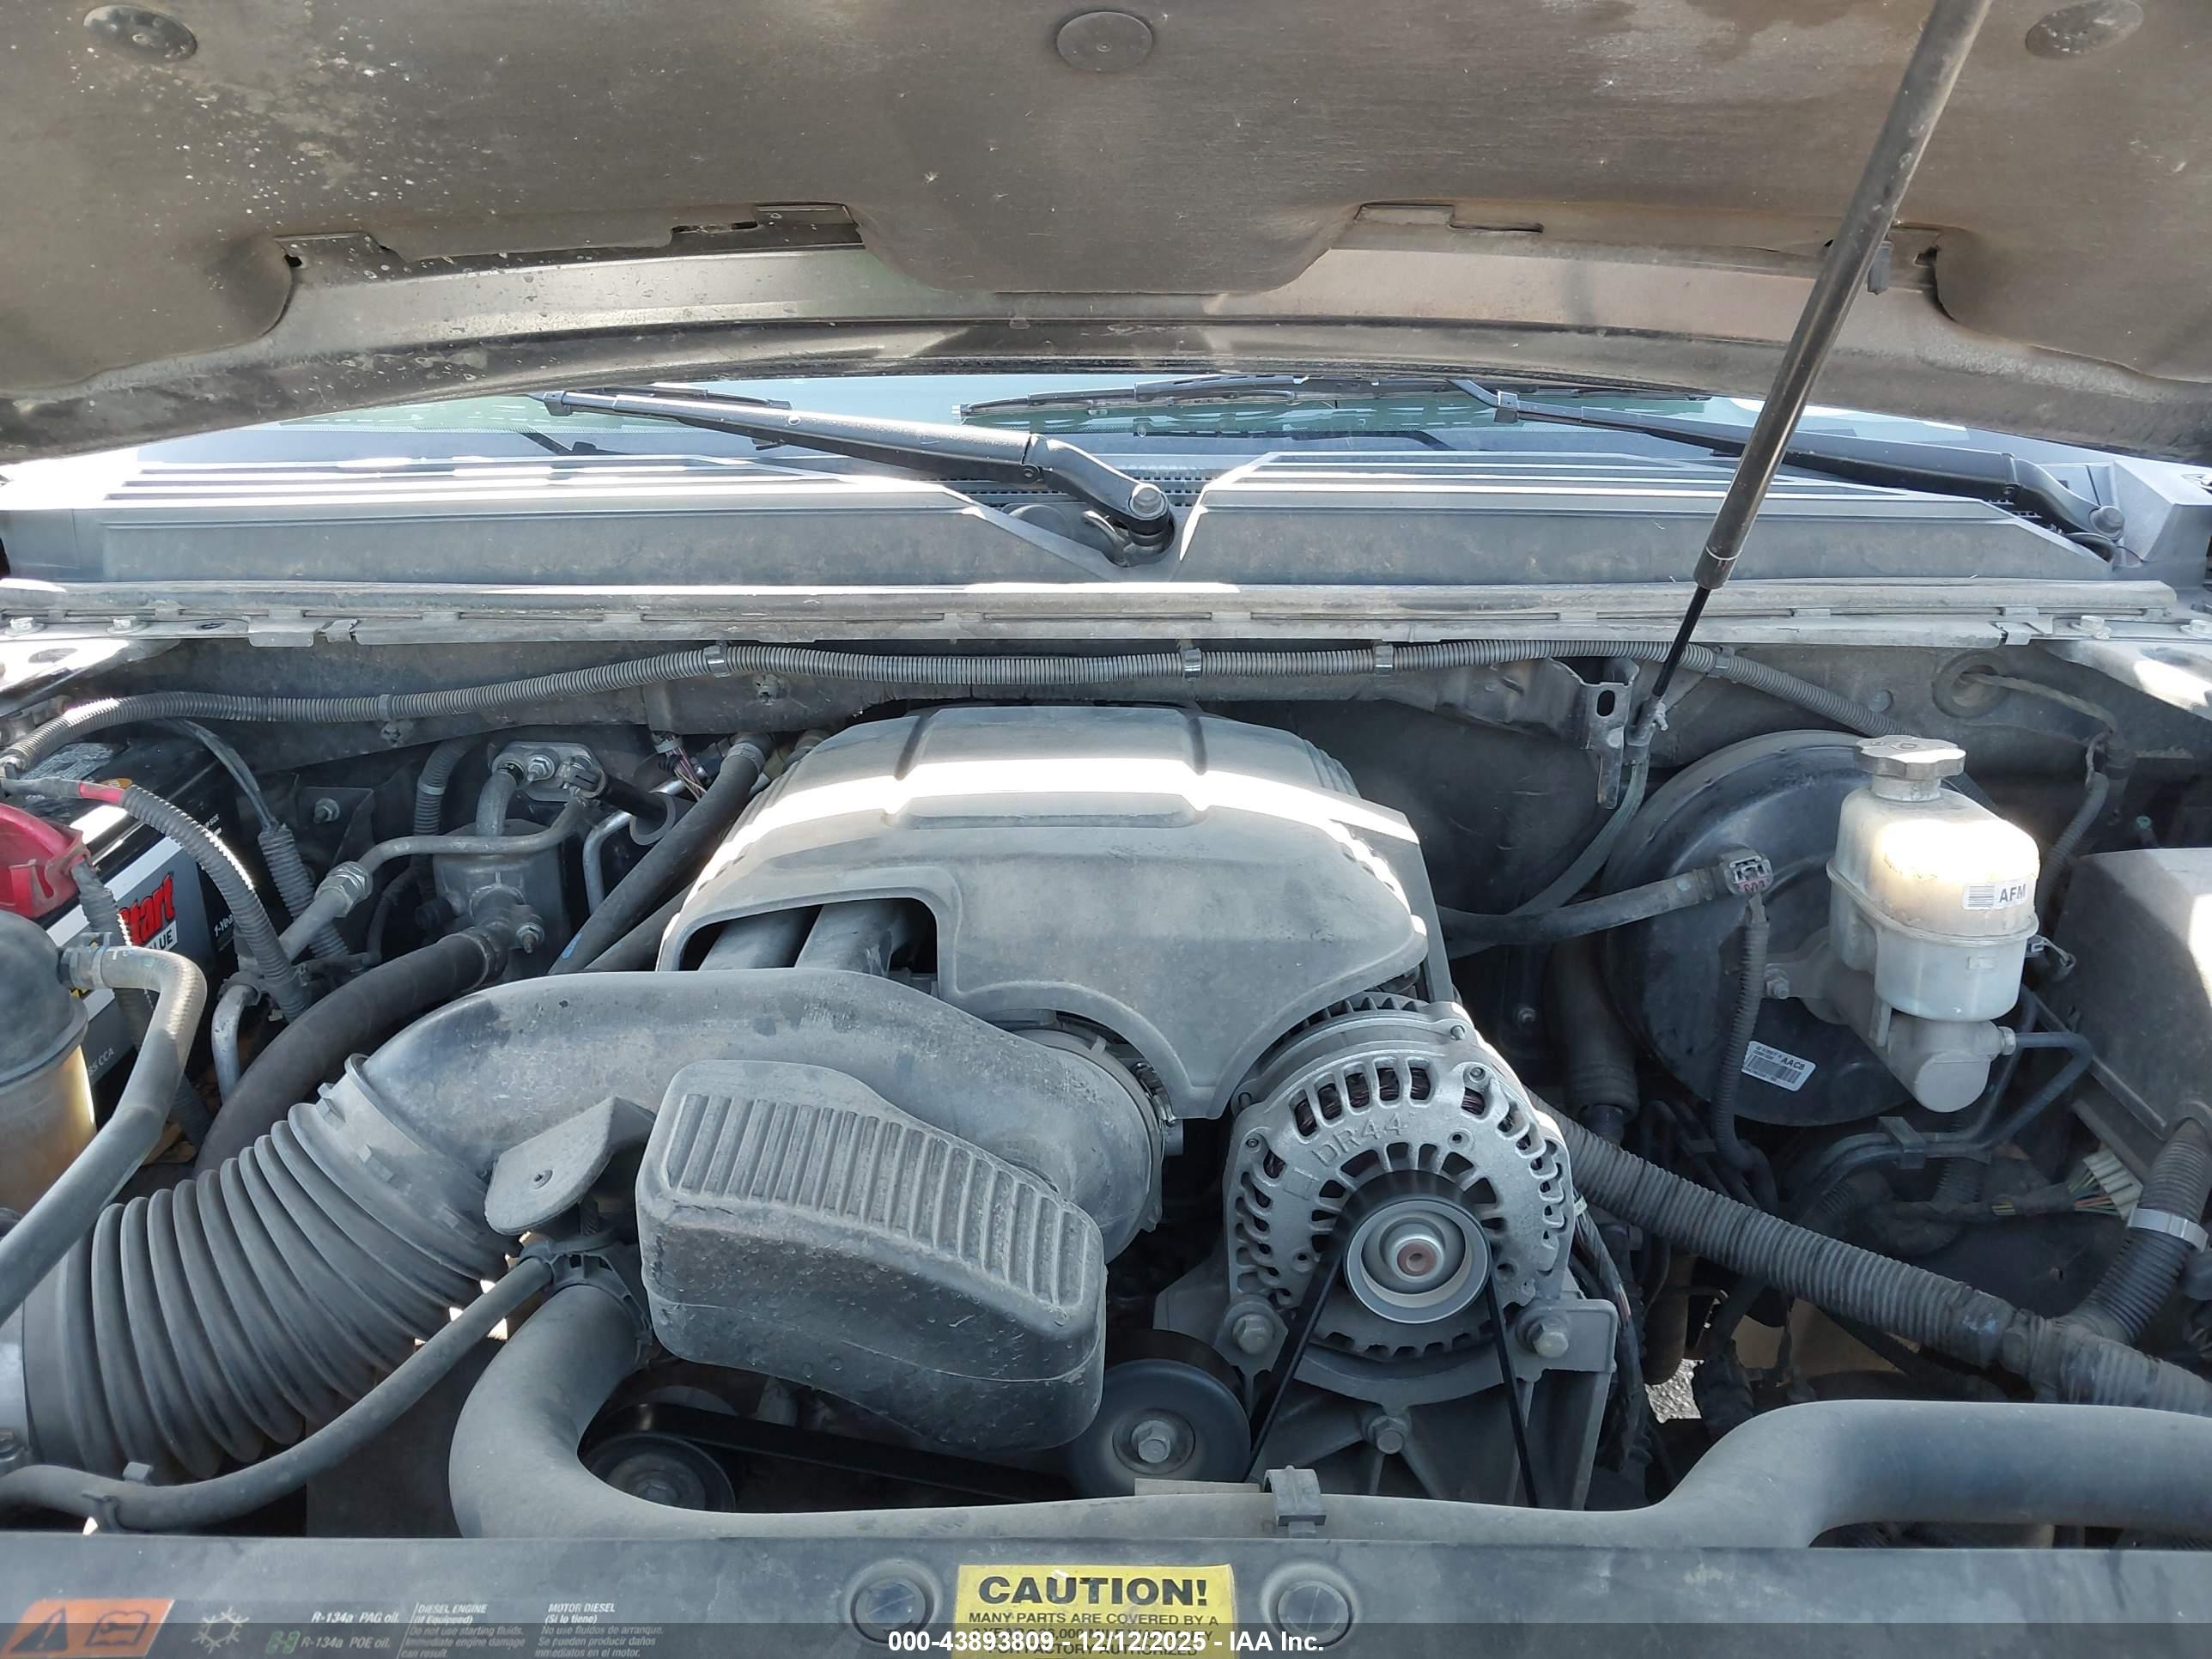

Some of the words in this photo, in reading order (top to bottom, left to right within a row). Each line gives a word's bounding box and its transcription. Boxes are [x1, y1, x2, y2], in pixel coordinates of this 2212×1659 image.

[1998, 883, 2027, 903] AFM
[149, 929, 173, 950] LUE
[98, 1047, 115, 1066] CCA
[978, 1575, 1206, 1606] CAUTION!
[418, 1604, 449, 1613] DIESEL
[453, 1604, 488, 1614] ENGINE
[549, 1603, 581, 1613] MOTOR
[584, 1603, 615, 1613] DIESEL
[311, 1611, 354, 1623] R-134a
[359, 1612, 382, 1623] PAG
[969, 1613, 1012, 1623] MANY
[1017, 1613, 1065, 1623] PARTS
[1071, 1613, 1101, 1624] ARE
[1105, 1613, 1178, 1626] COVERED
[1183, 1615, 1203, 1626] BY
[1208, 1616, 1218, 1626] A
[607, 1626, 618, 1634] de
[301, 1636, 344, 1648] R-134a
[349, 1636, 374, 1649] POE
[455, 1638, 487, 1649] engine
[489, 1638, 526, 1650] damage
[587, 1637, 626, 1647] producir
[611, 1649, 641, 1657] motor.
